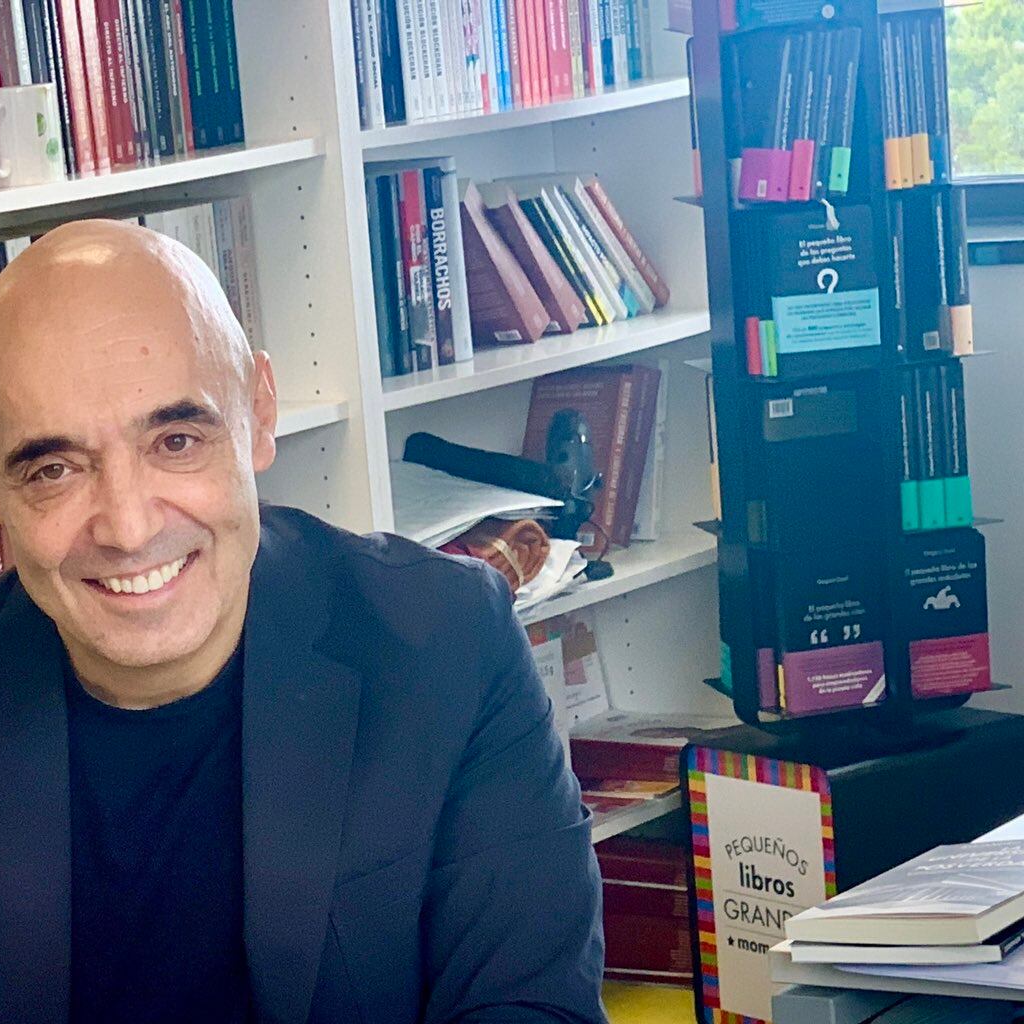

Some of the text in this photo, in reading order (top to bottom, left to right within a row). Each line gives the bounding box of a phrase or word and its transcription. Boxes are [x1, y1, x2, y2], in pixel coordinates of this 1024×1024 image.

[102, 21, 118, 106] DIRECTO AL INFIERNO
[113, 18, 128, 103] DIRECTO AL INFIERNO
[406, 31, 415, 80] BLOCKCHAIN
[419, 29, 429, 78] BLOCKCHAIN
[429, 207, 452, 310] BORRACHOS
[807, 238, 835, 248] pequeño
[725, 835, 809, 875] PEQUEÑOS
[739, 862, 794, 897] libros
